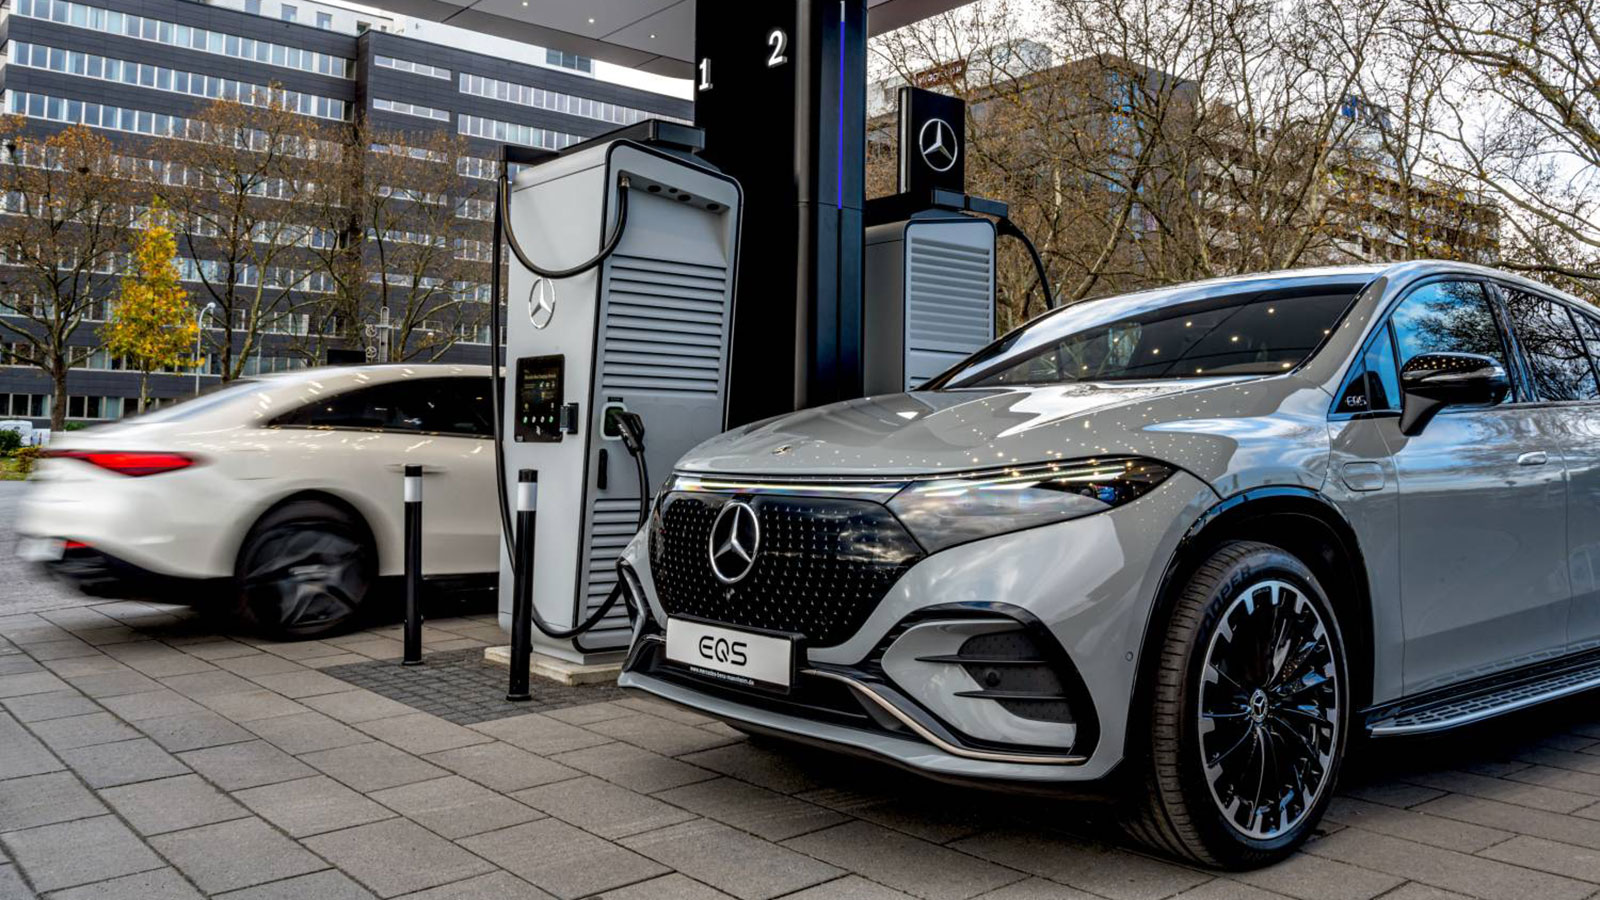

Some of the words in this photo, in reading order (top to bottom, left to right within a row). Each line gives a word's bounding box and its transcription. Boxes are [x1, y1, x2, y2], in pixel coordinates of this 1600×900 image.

[767, 29, 788, 68] 2
[698, 57, 713, 91] 1
[699, 635, 747, 666] EQS
